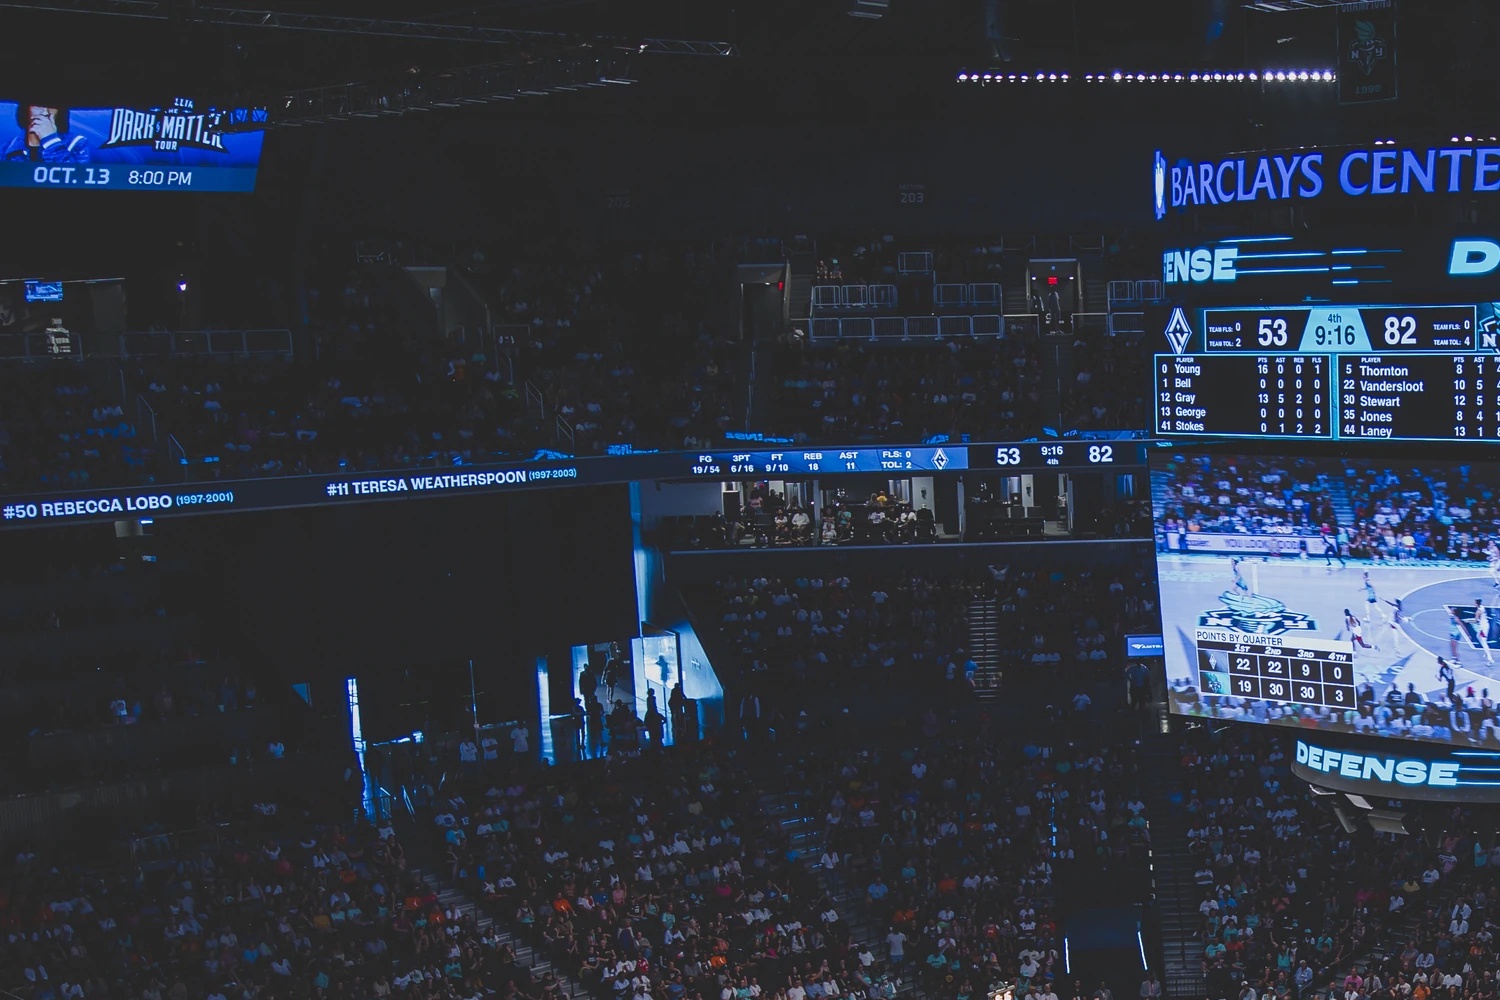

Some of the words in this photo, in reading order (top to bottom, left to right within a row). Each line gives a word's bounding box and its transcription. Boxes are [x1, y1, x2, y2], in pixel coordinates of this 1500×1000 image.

[107, 109, 155, 144] DARK
[155, 141, 177, 150] TOUR
[34, 167, 76, 184] OCT.
[84, 168, 110, 184] 13
[128, 171, 164, 184] 8:00
[168, 172, 192, 185] PM
[1172, 154, 1323, 207] BARCLAYS
[1327, 314, 1342, 323] 4th
[1258, 319, 1287, 346] 53
[1315, 325, 1356, 346] 9:16
[1384, 316, 1417, 345] 82
[1162, 364, 1168, 373] 0
[1174, 364, 1201, 376] Young
[1345, 364, 1352, 374] 5
[1359, 365, 1409, 376] Thornton
[1163, 378, 1168, 388] 1
[1175, 378, 1191, 388] Bell
[1343, 380, 1355, 390] 22
[1360, 380, 1424, 392] Vandersloot
[1160, 392, 1170, 402] 12
[1175, 392, 1195, 404] Gray
[1343, 395, 1355, 404] 30
[1360, 395, 1401, 407] Stewart
[1161, 407, 1170, 416] 13
[1175, 407, 1206, 419] George
[1344, 410, 1355, 420] 35
[1360, 411, 1393, 422] Jones
[1161, 421, 1171, 430] 41
[1175, 421, 1204, 431] Stokes
[1344, 425, 1356, 434] 44
[1360, 425, 1392, 438] Laney
[883, 451, 902, 459] FLS:
[996, 447, 1021, 465] 53
[1041, 446, 1064, 456] 9:16
[1089, 446, 1113, 462] 82
[808, 463, 819, 471] 18
[846, 462, 855, 470] 11
[881, 461, 902, 469] TOL:
[906, 461, 912, 469] 2
[327, 483, 349, 497] #11
[351, 479, 408, 495] TERESA
[410, 471, 526, 491] WEATHERSPOON
[528, 468, 577, 482] (1997-2003)
[3, 504, 37, 519] #50
[42, 500, 122, 517] REBECCA
[126, 495, 173, 512] LOBO
[176, 491, 234, 506] (1997-2001)
[1196, 632, 1227, 642] POINTS
[1229, 634, 1240, 642] BY
[1242, 635, 1283, 646] QUARTER
[1234, 644, 1250, 653] 1ST
[1264, 647, 1282, 656] 2ND
[1297, 650, 1315, 659] 3RD
[1328, 653, 1346, 662] 4TH
[1236, 658, 1251, 671] 22
[1267, 661, 1282, 674] 22
[1301, 664, 1310, 677] 9
[1333, 667, 1342, 679] 0
[1238, 680, 1252, 692] 19
[1269, 683, 1283, 696] 30
[1300, 686, 1315, 699] 30
[1335, 690, 1344, 702] 3
[1296, 740, 1460, 786] DEFENSE
